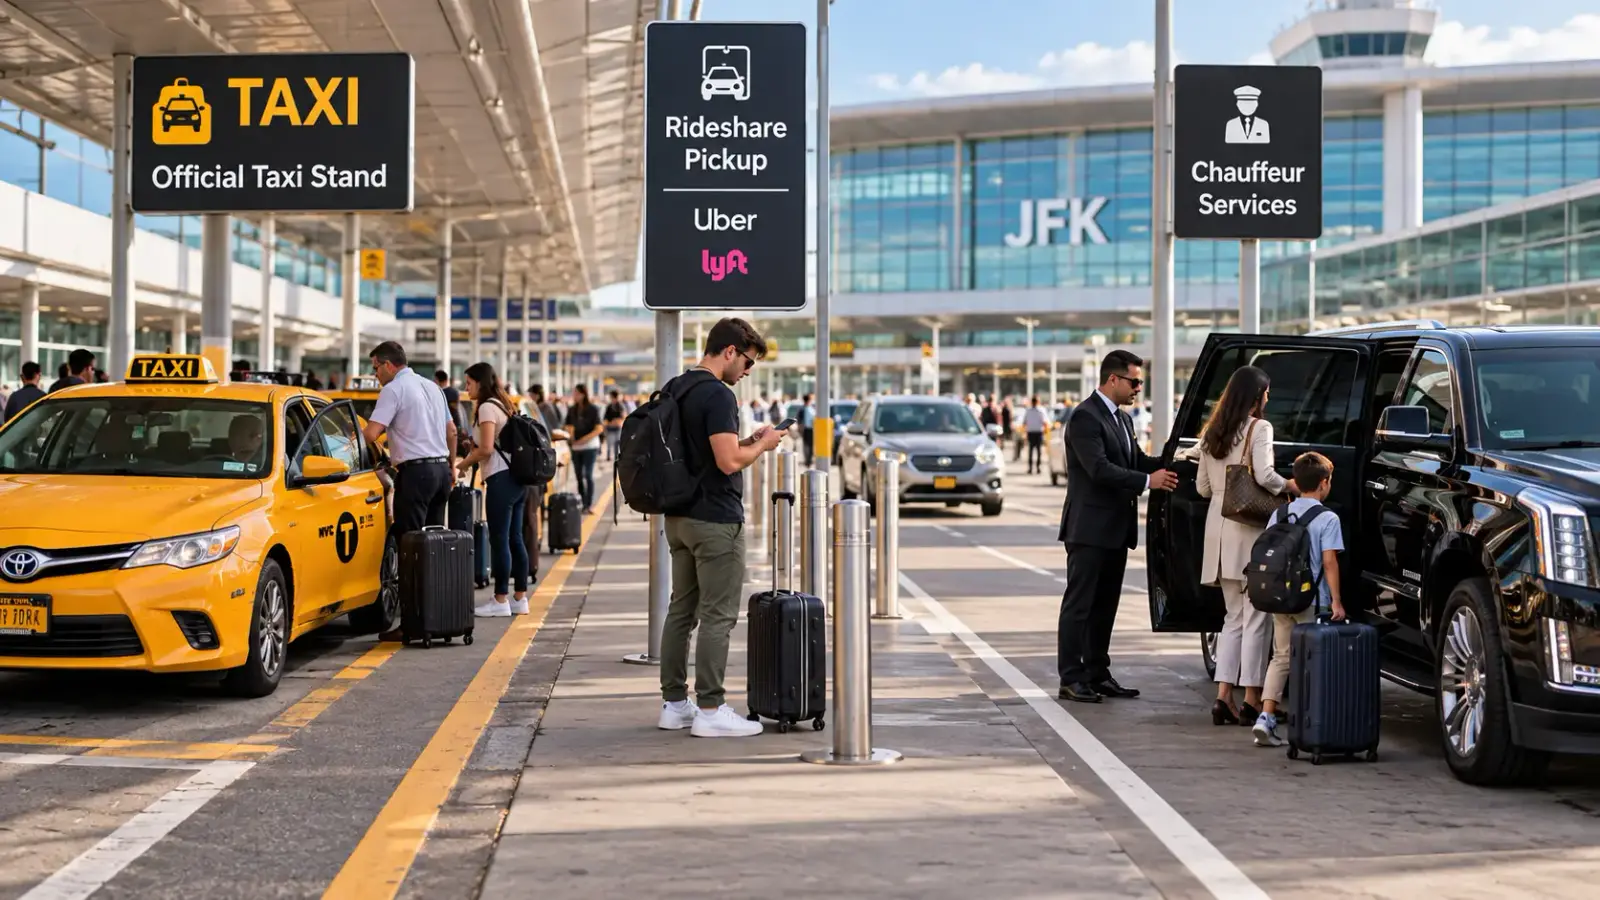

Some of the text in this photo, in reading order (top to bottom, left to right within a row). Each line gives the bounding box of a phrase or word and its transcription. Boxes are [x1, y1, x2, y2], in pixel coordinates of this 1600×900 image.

[228, 76, 359, 127] TAXI
[665, 115, 788, 139] Rideshare
[685, 148, 768, 176] Pickup
[1191, 160, 1305, 183] Chauffeur
[151, 163, 387, 190] Official Taxi Stand
[1198, 192, 1297, 216] Services
[694, 208, 758, 231] Uber
[1004, 196, 1108, 248] JFK
[701, 249, 749, 282] lyft
[138, 359, 193, 377] TAXI
